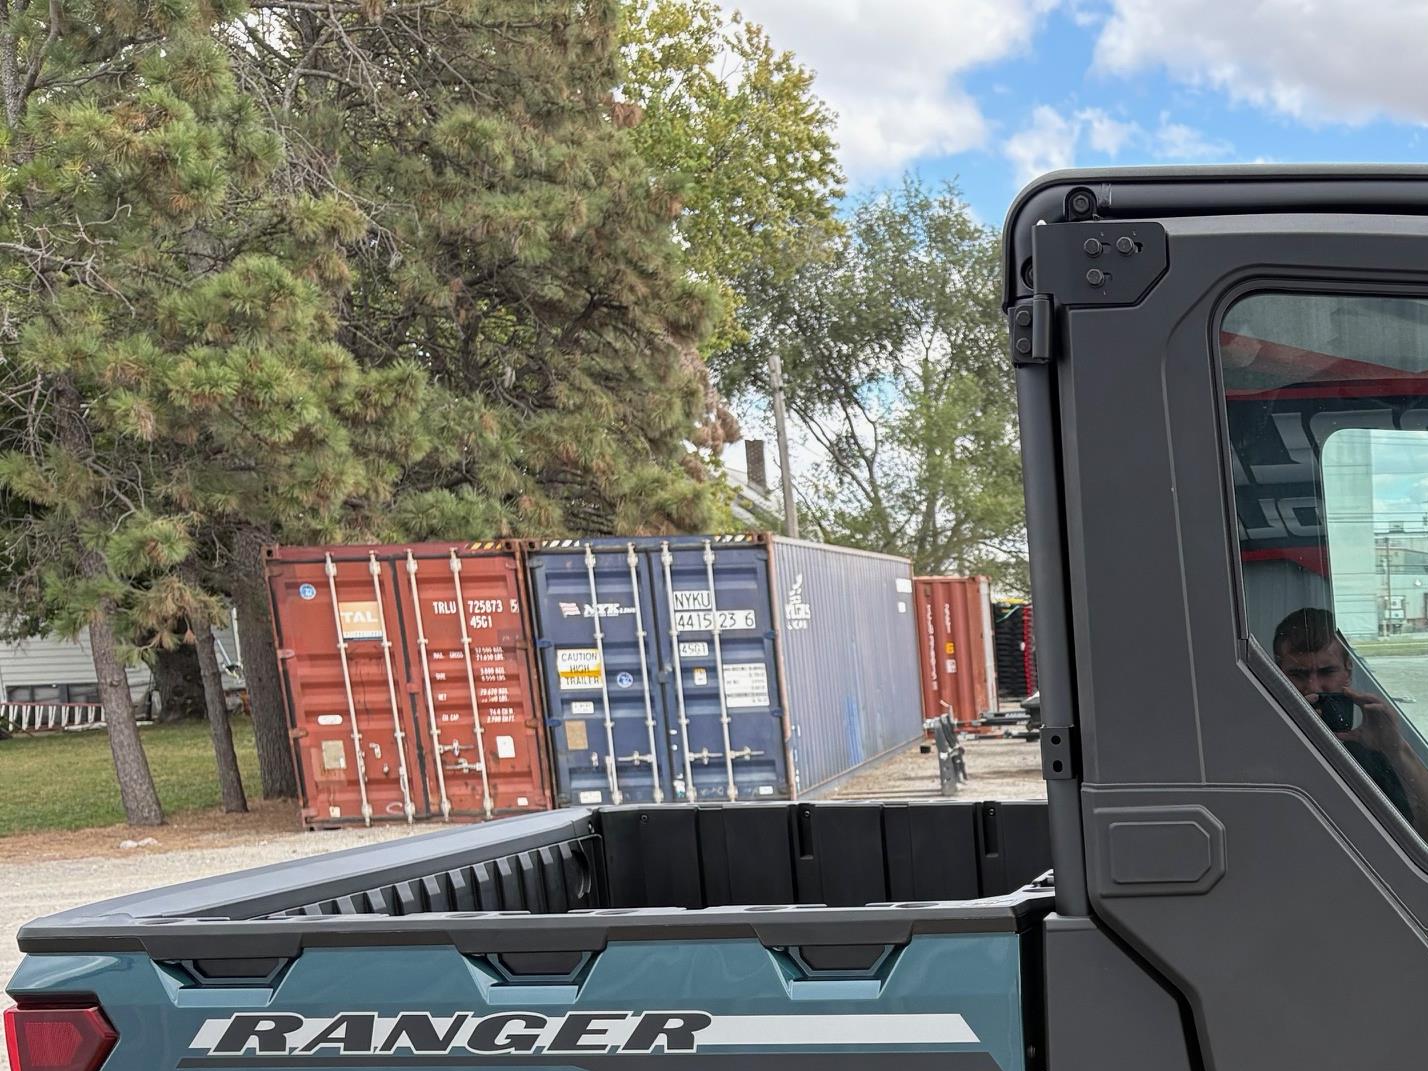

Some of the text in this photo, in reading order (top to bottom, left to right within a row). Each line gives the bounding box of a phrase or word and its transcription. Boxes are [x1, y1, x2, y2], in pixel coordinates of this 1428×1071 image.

[675, 592, 711, 609] NYKU
[433, 601, 456, 615] TRLU
[468, 600, 503, 613] 725873
[340, 611, 378, 624] TAL
[470, 616, 492, 628] 45G1
[561, 652, 598, 663] CAUTION
[565, 676, 600, 686] TRAILER
[207, 1010, 712, 1055] RANGER
